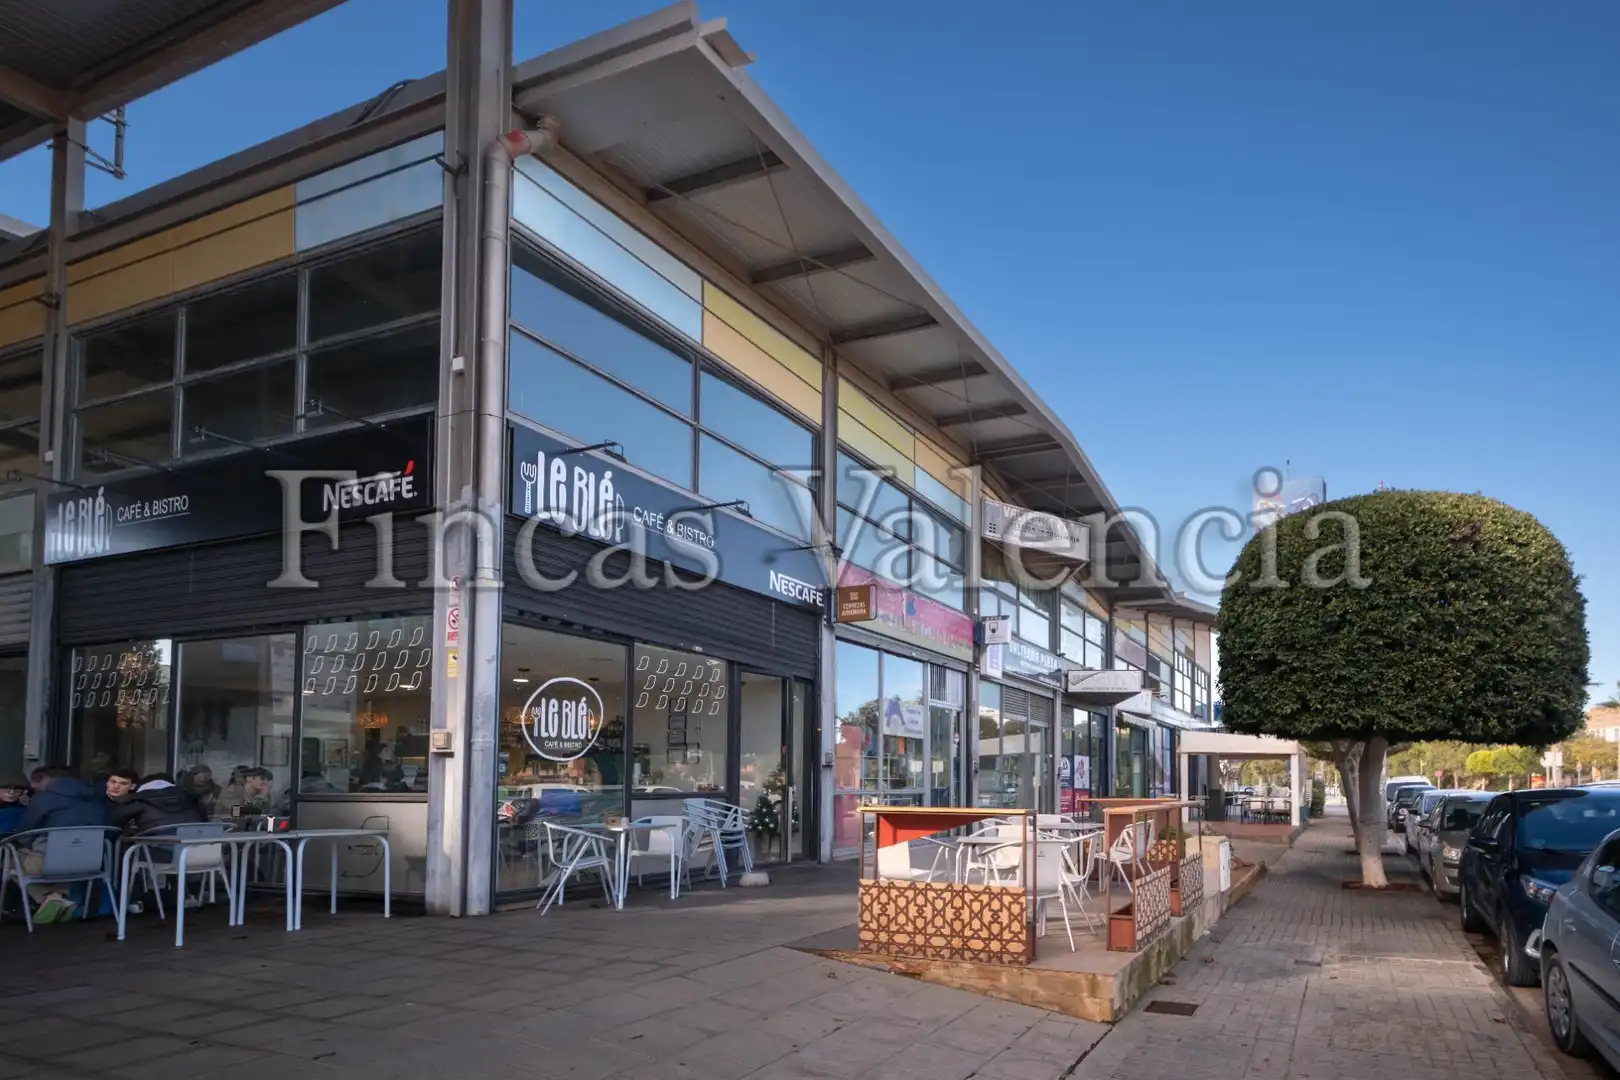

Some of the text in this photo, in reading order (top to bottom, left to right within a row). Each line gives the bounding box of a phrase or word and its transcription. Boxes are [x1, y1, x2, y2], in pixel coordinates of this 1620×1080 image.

[117, 495, 189, 522] CAFÉ & BISTRO
[633, 506, 715, 549] CAFÉ & BISTRO
